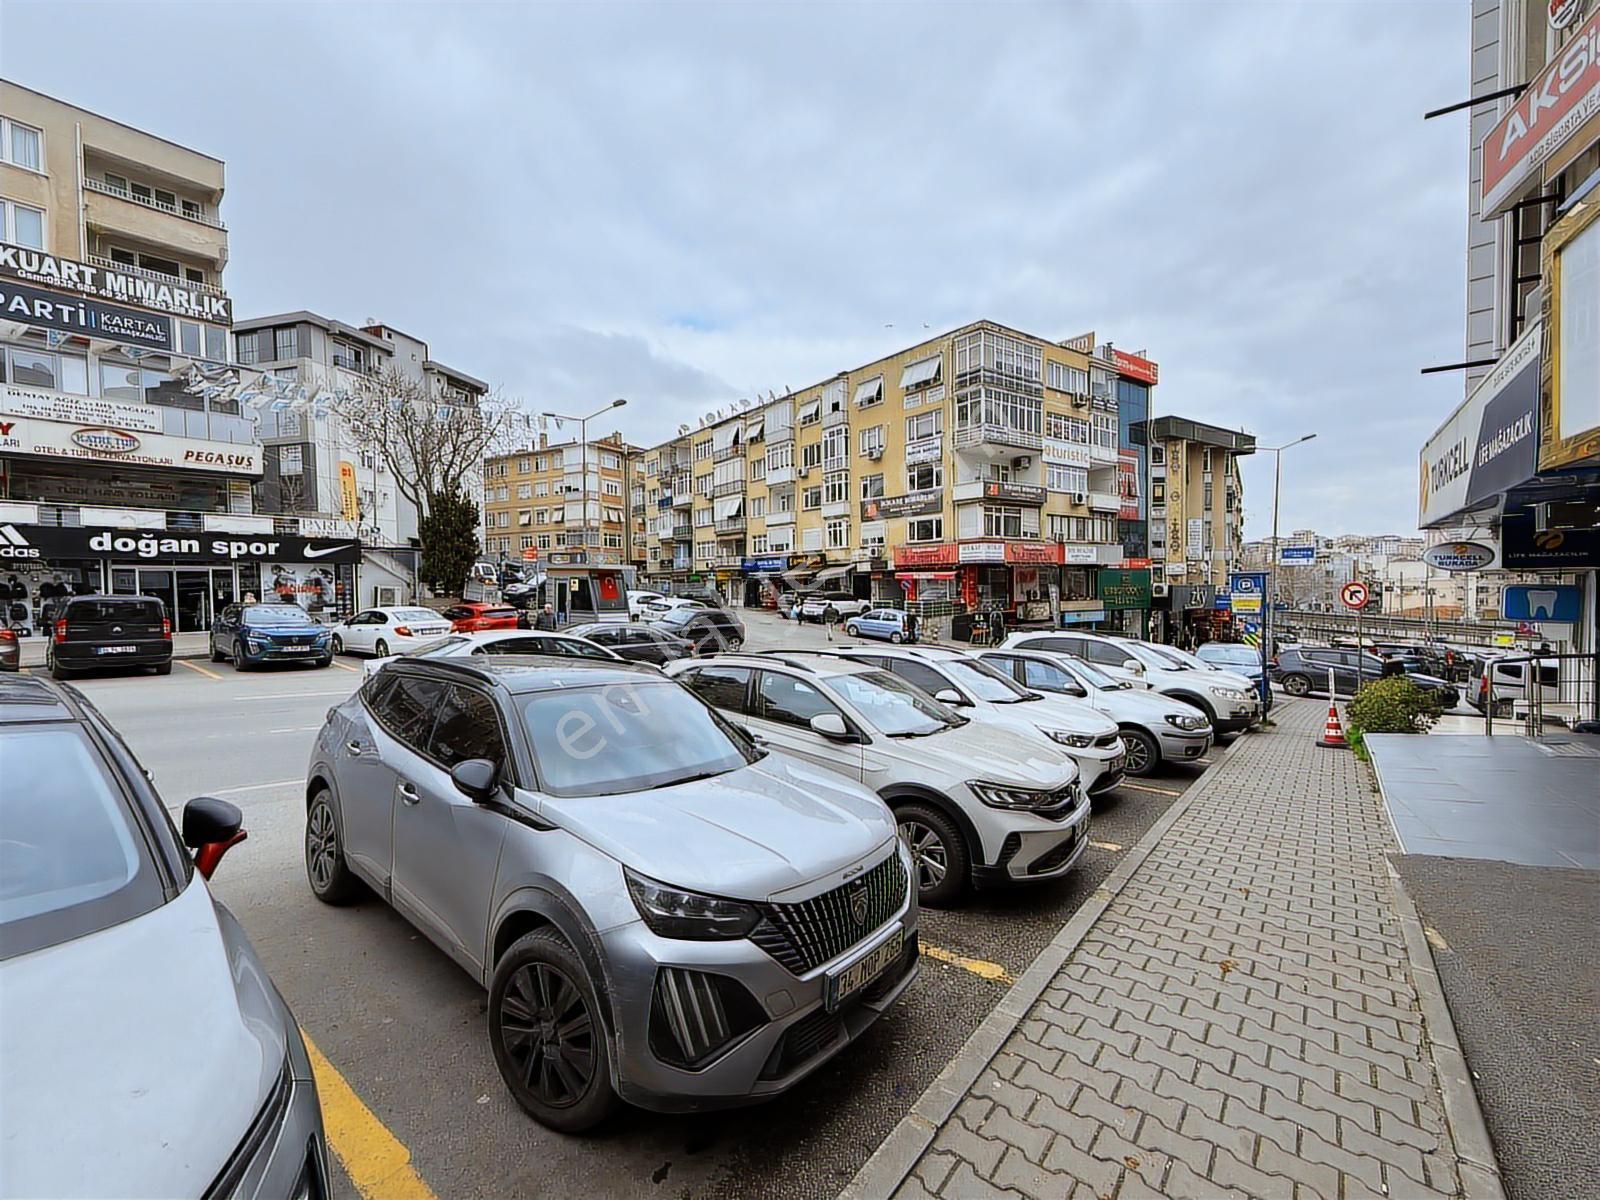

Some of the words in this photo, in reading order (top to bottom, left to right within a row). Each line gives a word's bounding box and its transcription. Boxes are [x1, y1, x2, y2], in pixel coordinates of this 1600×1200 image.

[0, 245, 97, 285] KUART
[101, 312, 167, 336] KARTAL
[33, 445, 57, 455] OTEL
[184, 449, 254, 467] PEGASUS
[1431, 436, 1469, 495] TURKCELL
[89, 532, 200, 558] doğan
[212, 540, 280, 559] spor
